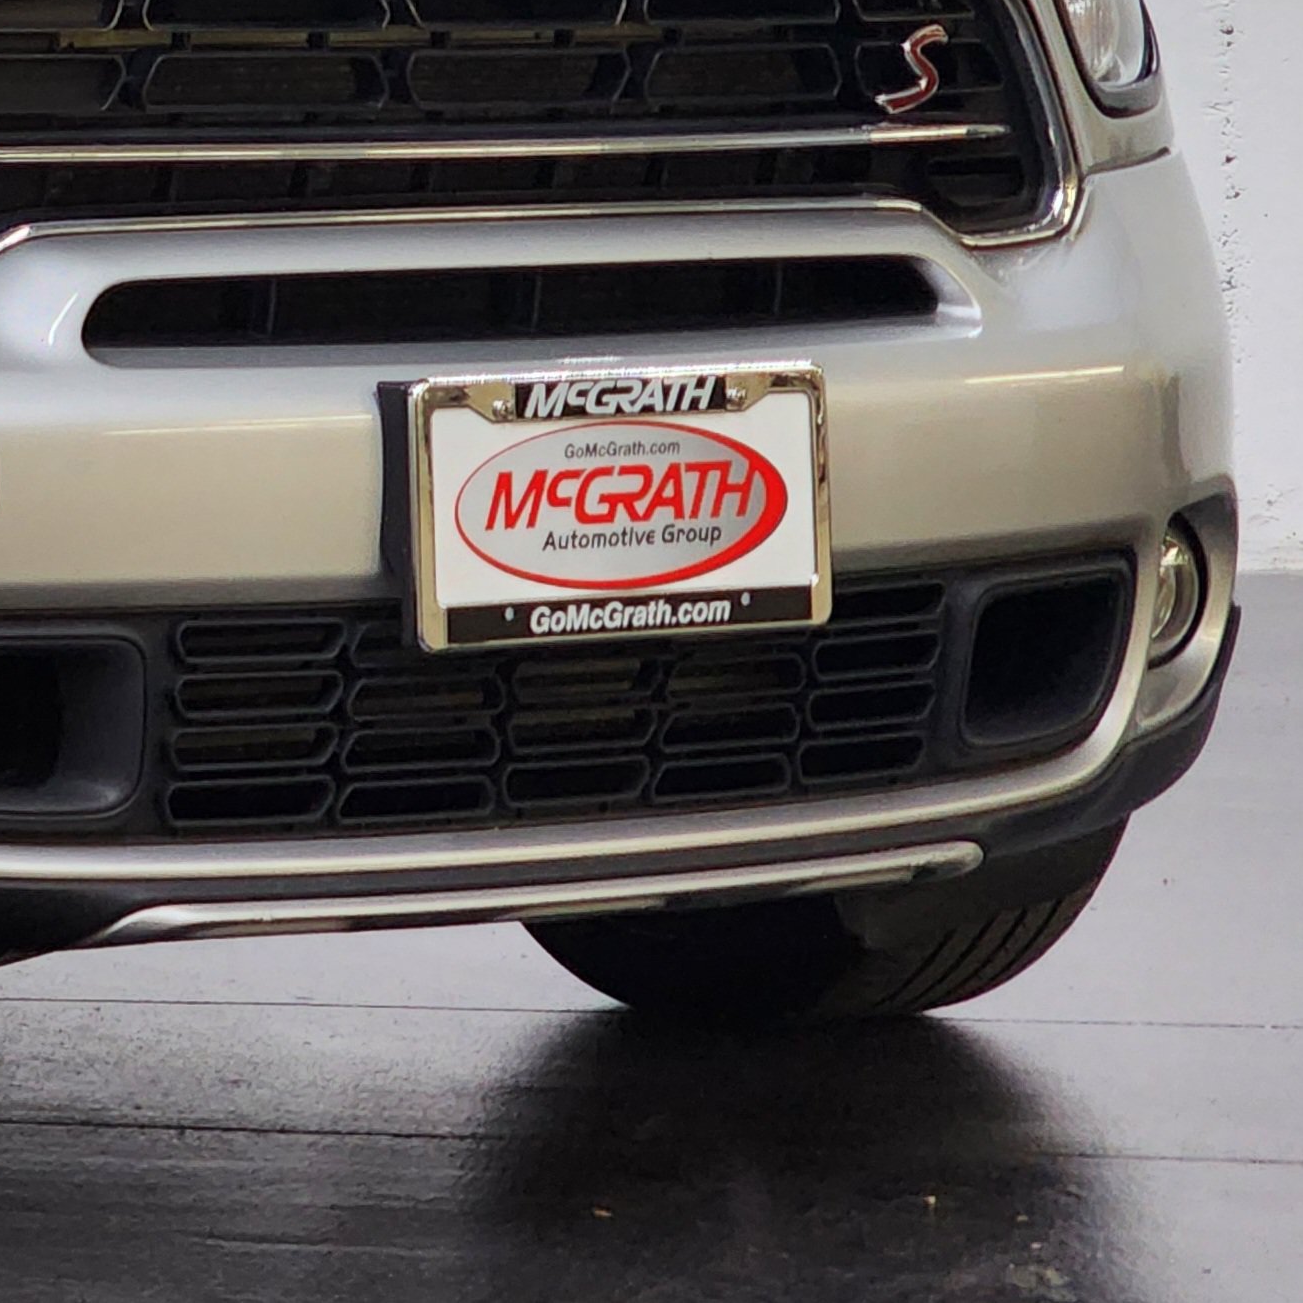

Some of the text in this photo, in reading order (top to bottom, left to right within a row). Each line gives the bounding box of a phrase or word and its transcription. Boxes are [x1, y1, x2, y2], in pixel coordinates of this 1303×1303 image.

[874, 23, 949, 114] S
[563, 439, 681, 459] GoMcGrath.com
[541, 522, 723, 552] Automotive Group
[529, 598, 732, 635] GoMcGrath.com
